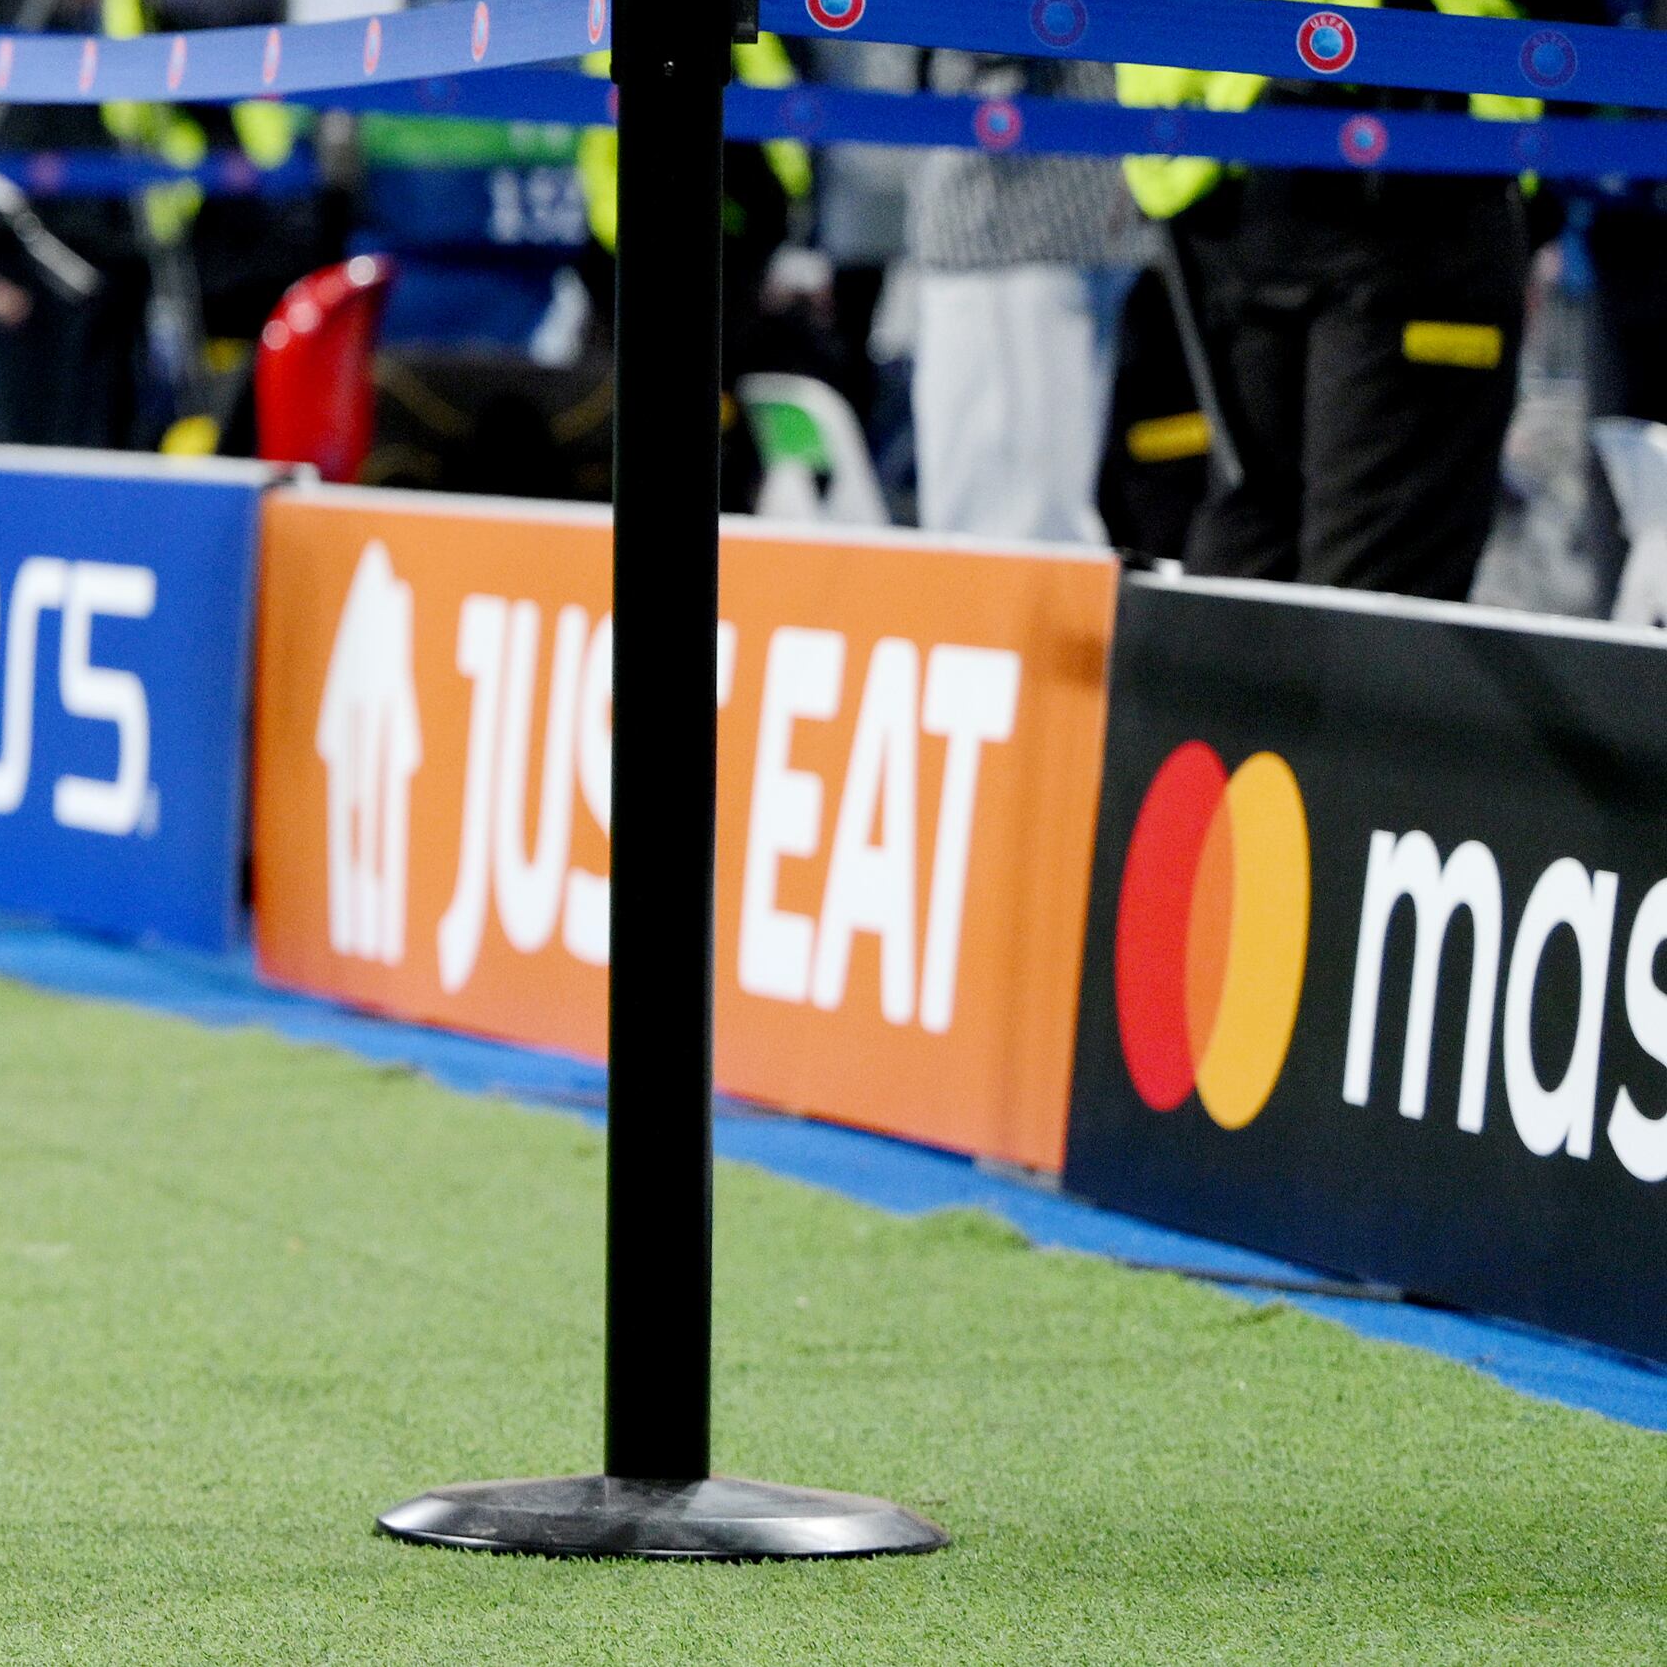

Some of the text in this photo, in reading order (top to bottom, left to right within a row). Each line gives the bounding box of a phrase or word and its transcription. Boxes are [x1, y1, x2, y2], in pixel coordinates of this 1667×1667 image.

[438, 593, 1021, 1034] JUS EAT
[1343, 829, 1667, 1182] mas
